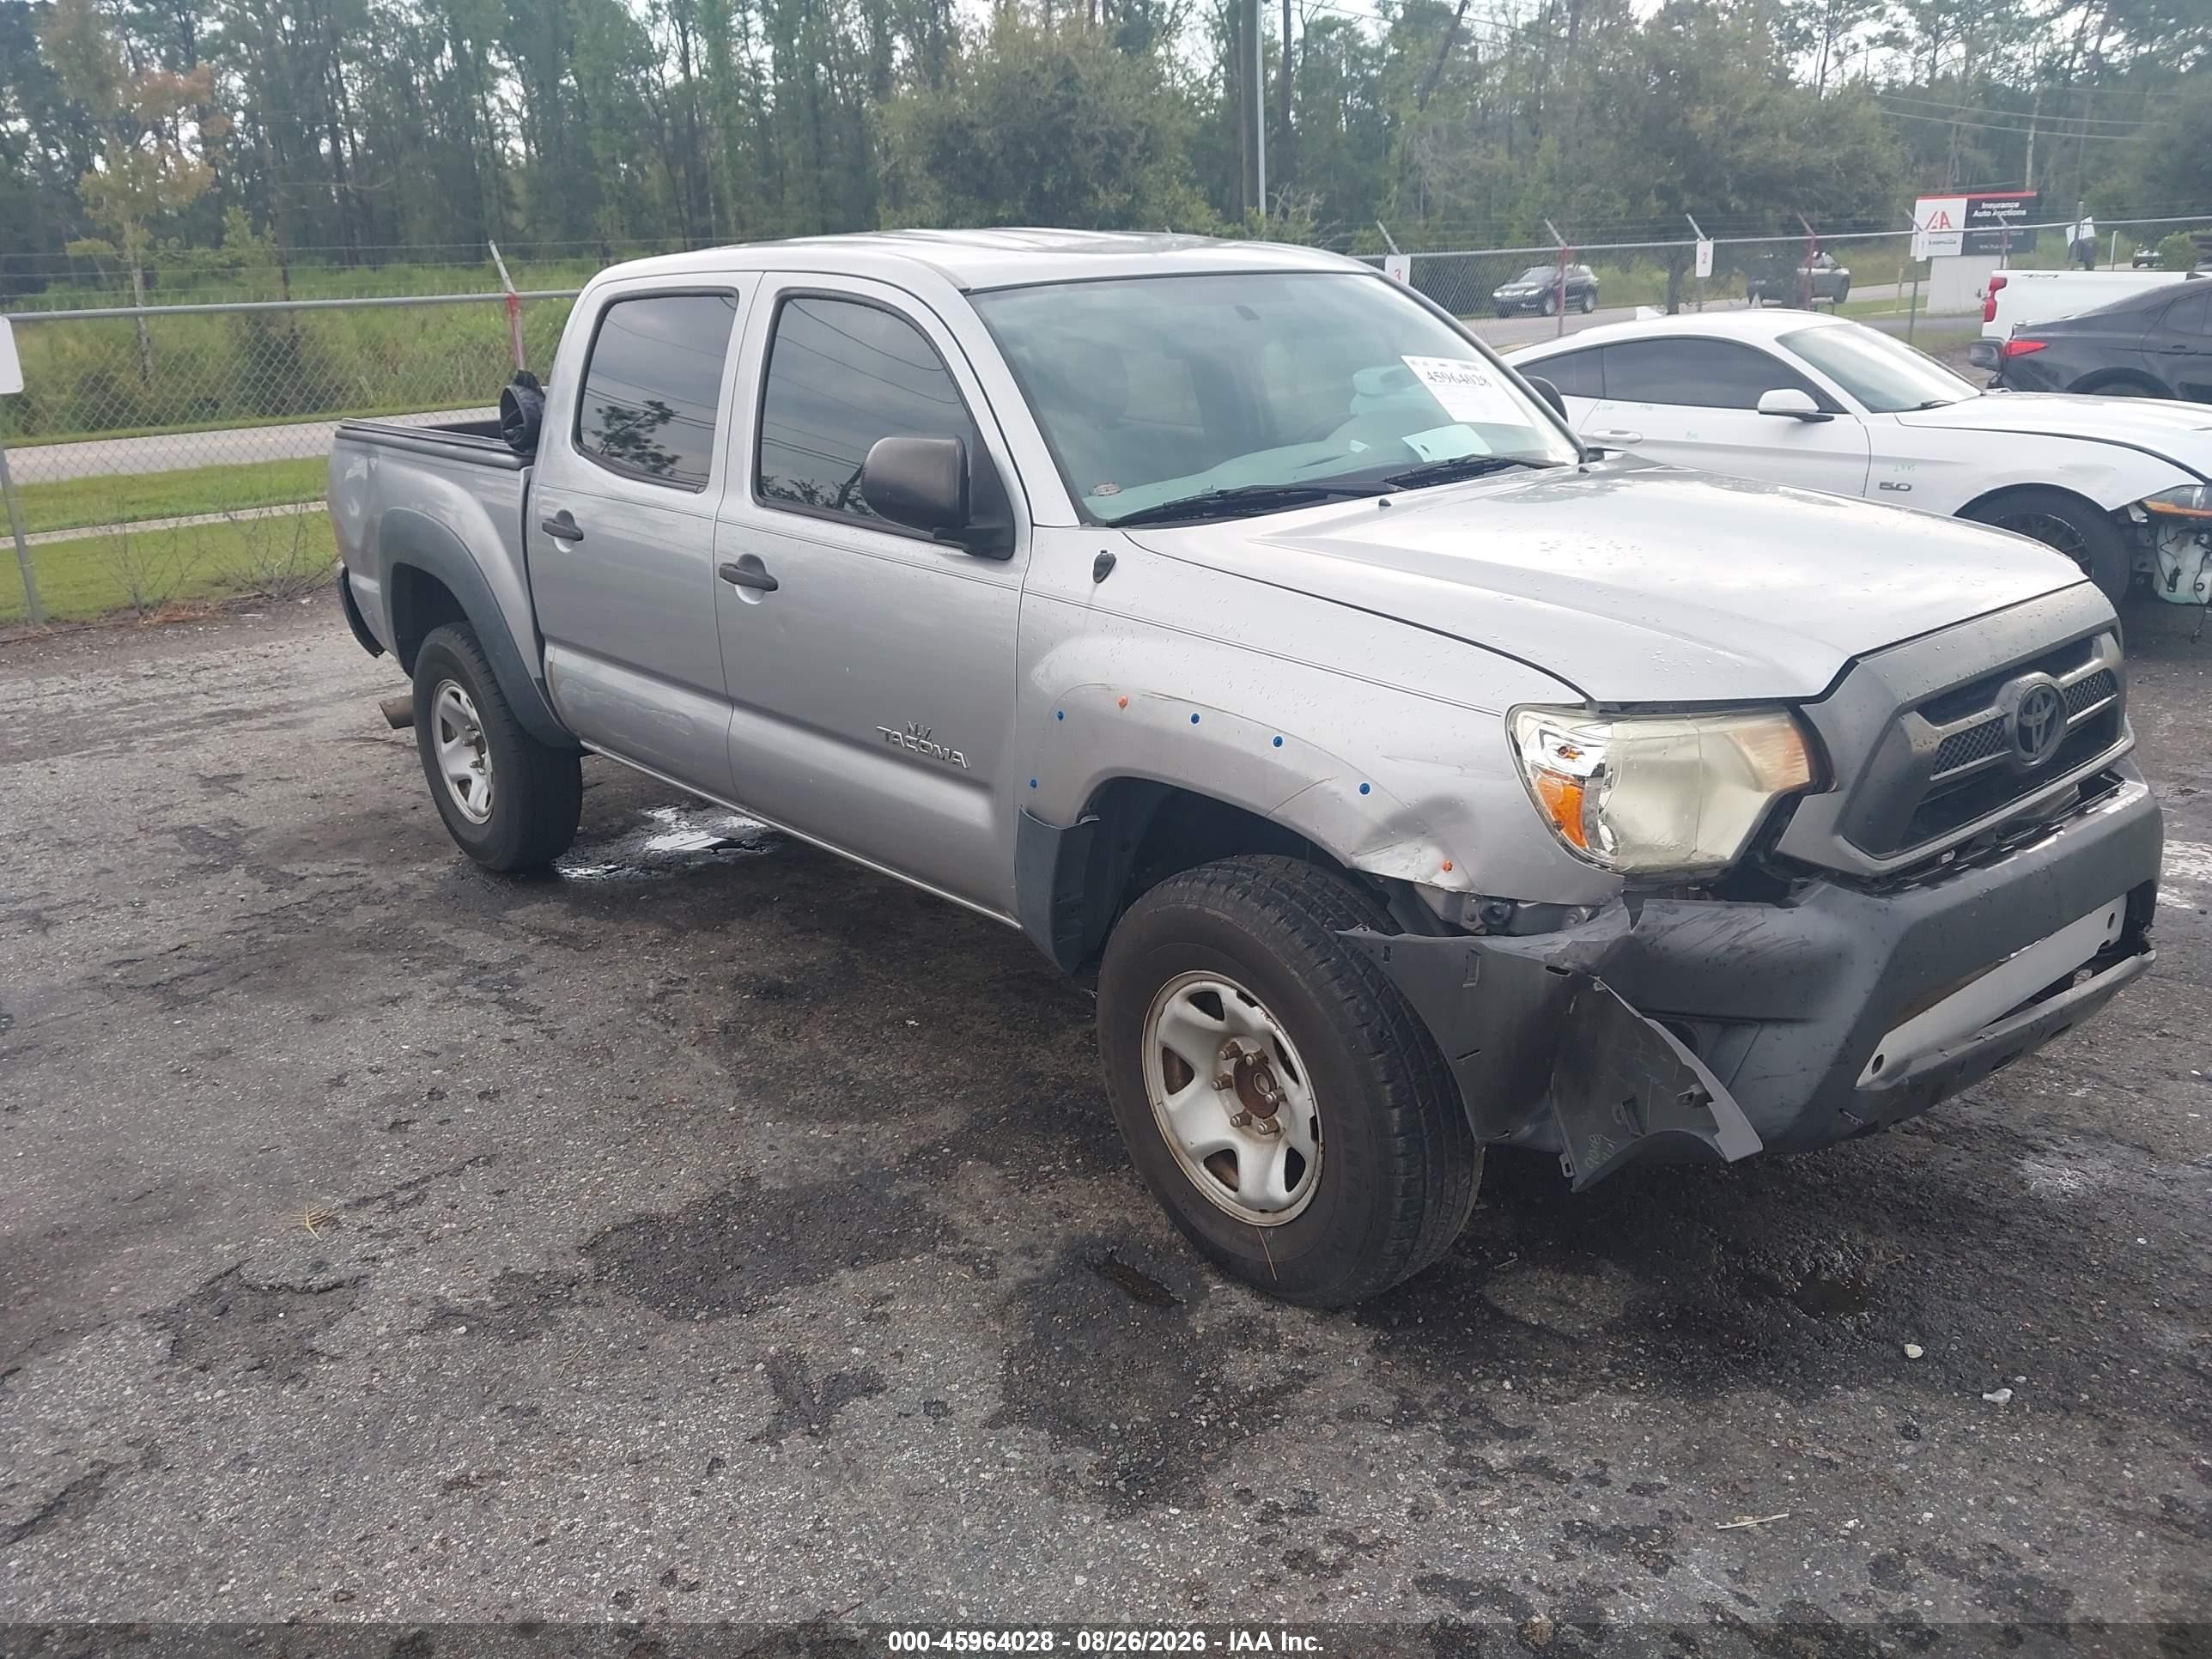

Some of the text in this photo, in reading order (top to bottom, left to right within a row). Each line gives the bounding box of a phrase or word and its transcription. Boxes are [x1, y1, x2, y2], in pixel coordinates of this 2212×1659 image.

[1981, 201, 2020, 210] Insurance
[1973, 210, 1991, 218] Auto
[1702, 252, 1708, 264] 2
[876, 726, 970, 769] TACOMA
